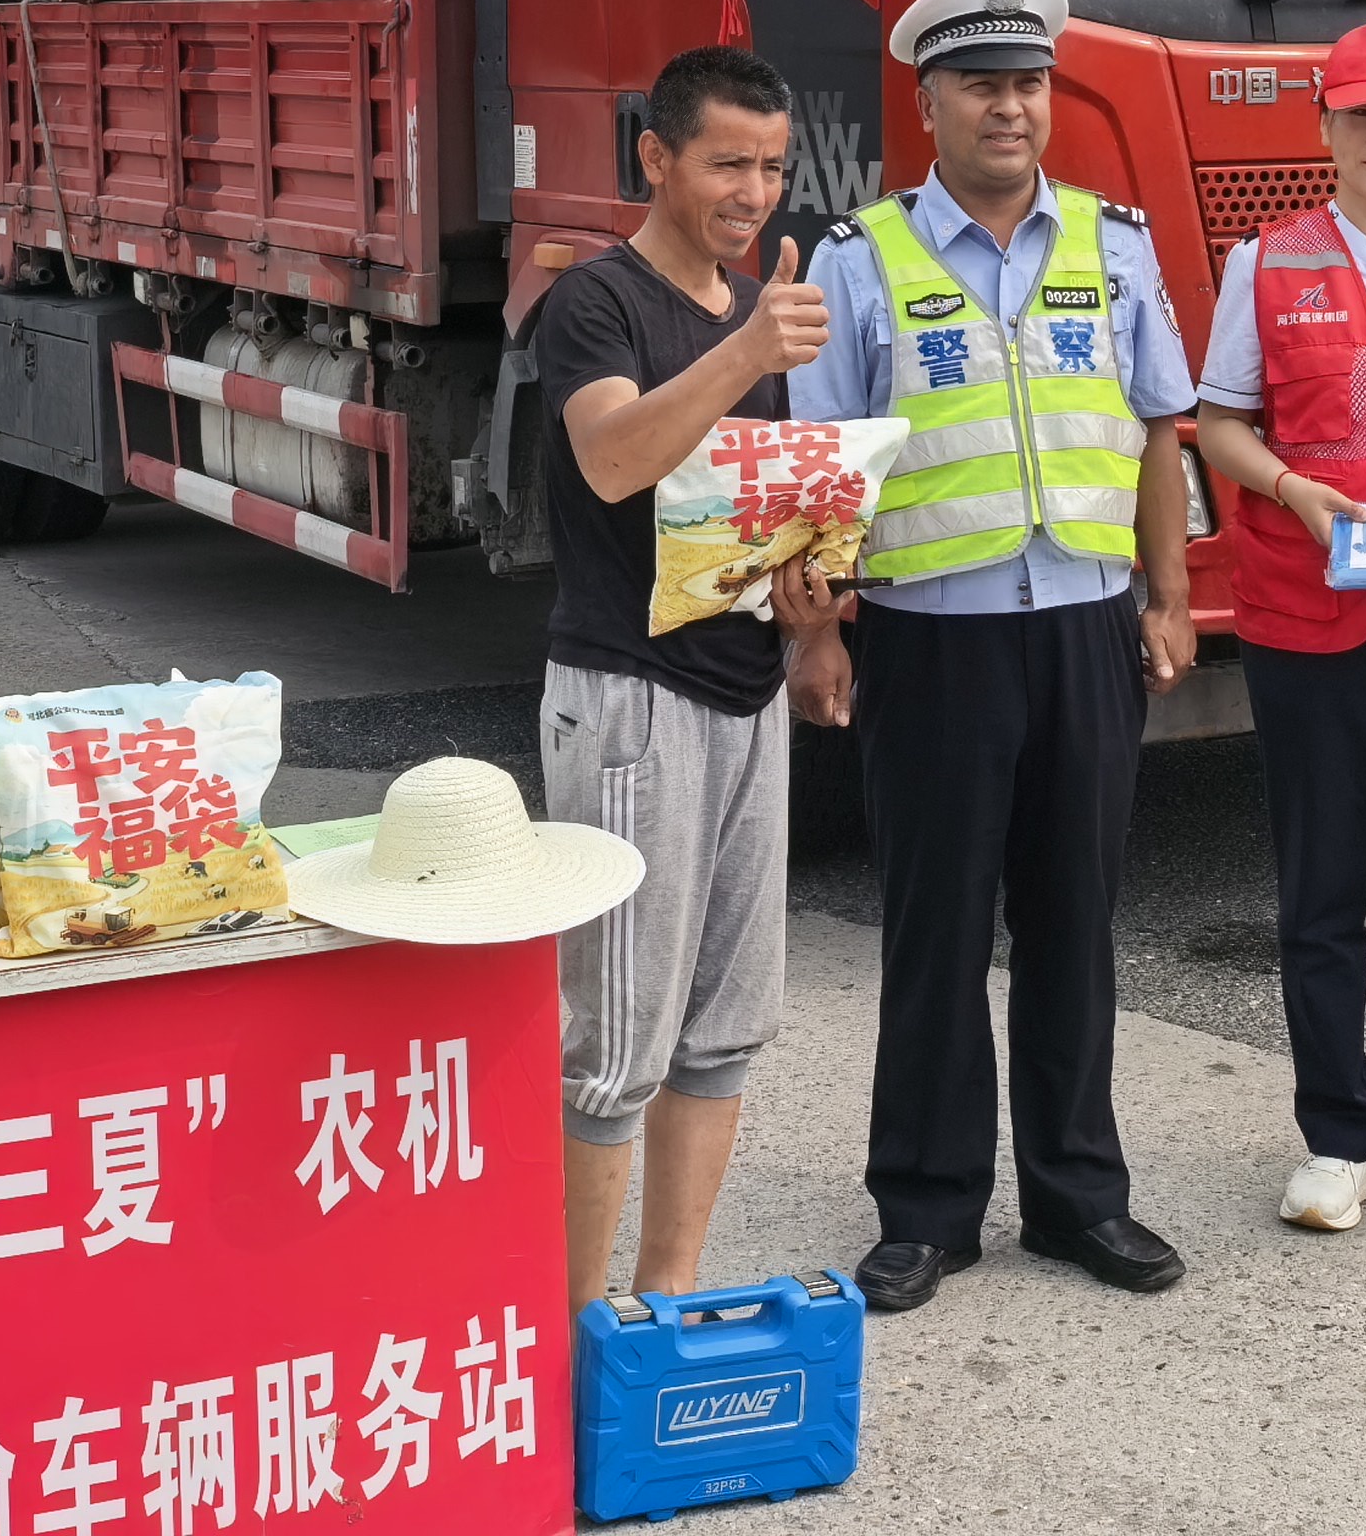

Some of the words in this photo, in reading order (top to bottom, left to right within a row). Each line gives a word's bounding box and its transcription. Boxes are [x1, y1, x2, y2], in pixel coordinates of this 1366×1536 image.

[1045, 289, 1097, 305] 002297
[1276, 310, 1348, 327] 河北高速集团
[916, 328, 970, 389] 警
[1048, 318, 1097, 374] 察
[709, 419, 843, 482] 平安
[727, 470, 866, 543] 福袋
[46, 717, 199, 804] 平安
[72, 773, 248, 879] 福袋
[293, 1037, 485, 1217] 农机
[668, 1386, 781, 1432] LUYING
[704, 1477, 747, 1495] 32PCS
